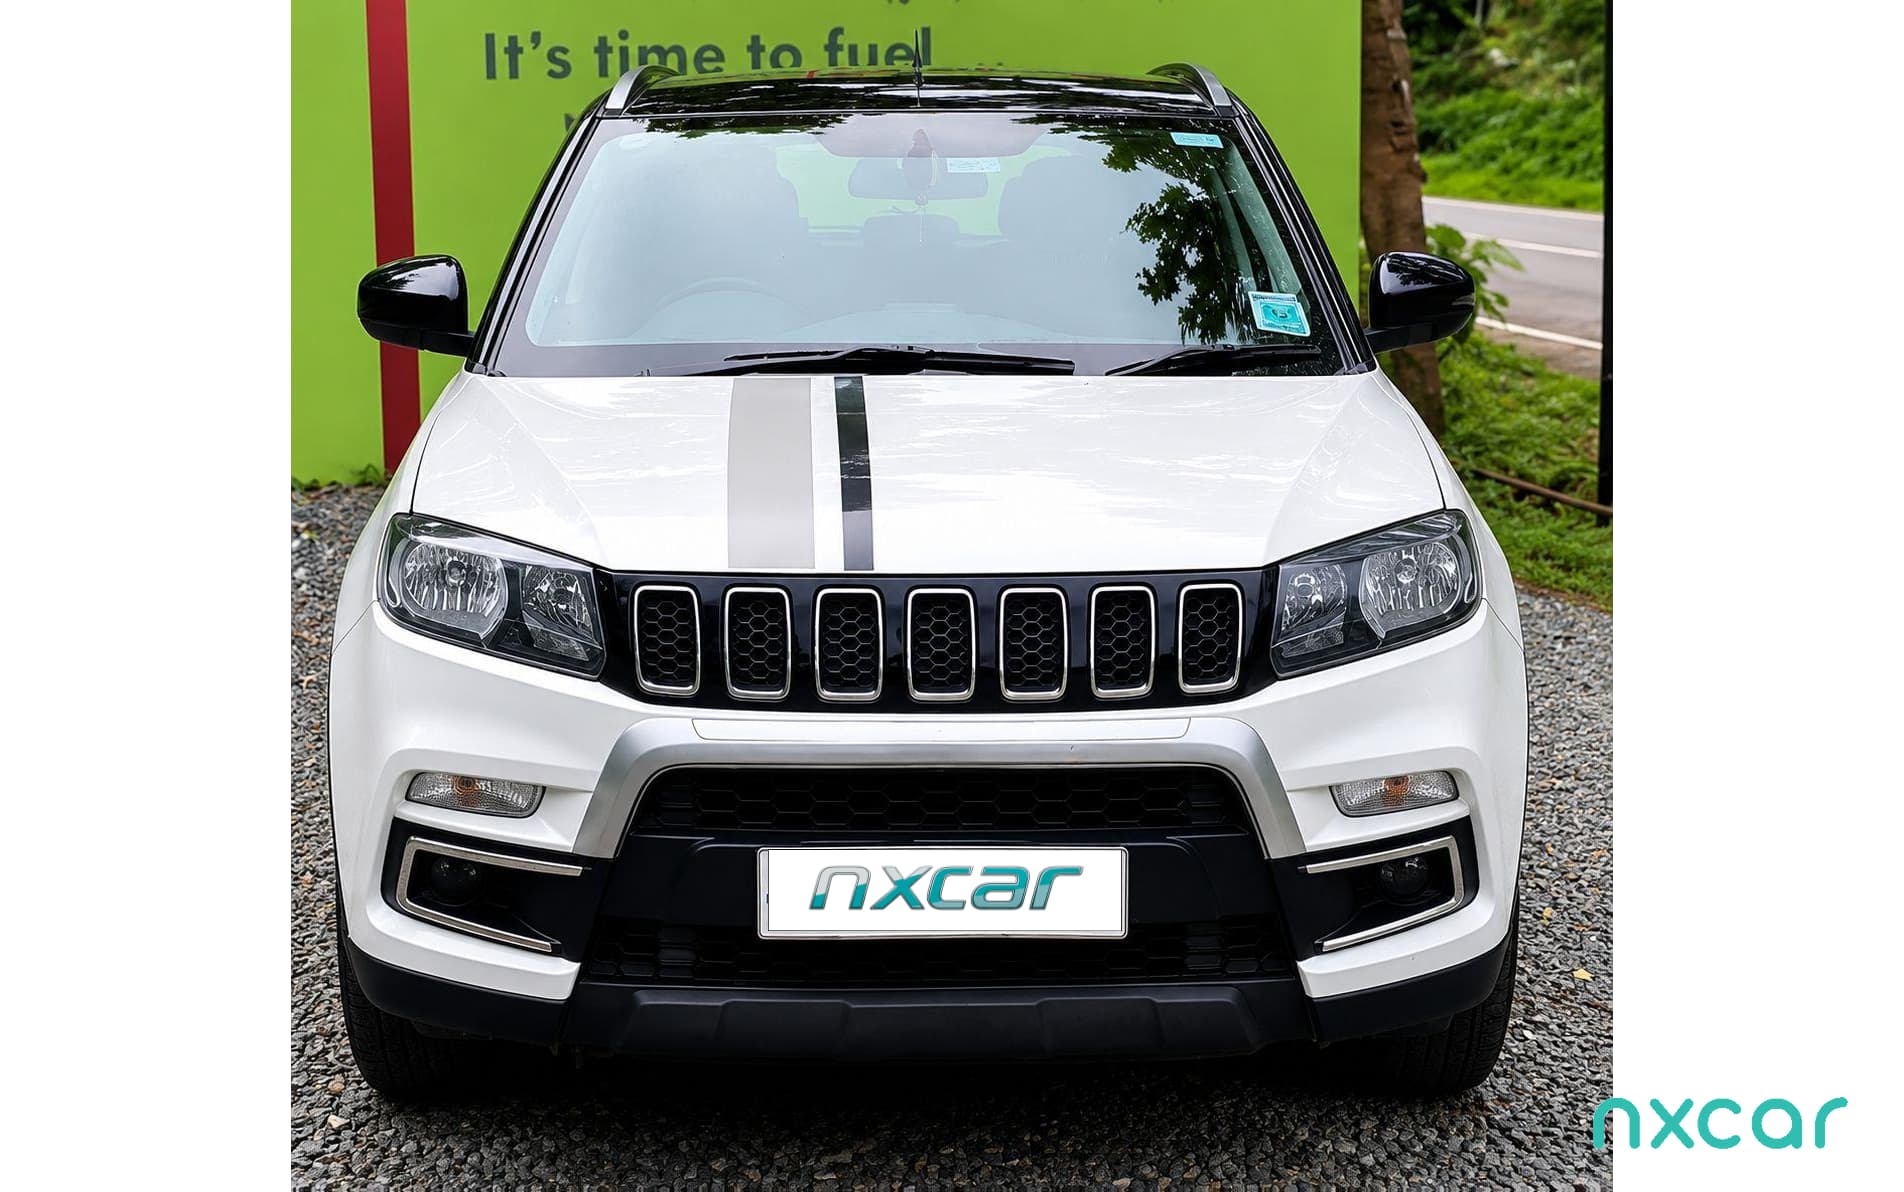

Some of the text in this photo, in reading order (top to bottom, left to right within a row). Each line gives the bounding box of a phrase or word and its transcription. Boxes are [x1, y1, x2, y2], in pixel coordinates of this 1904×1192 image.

[485, 26, 932, 80] It's time to fuel
